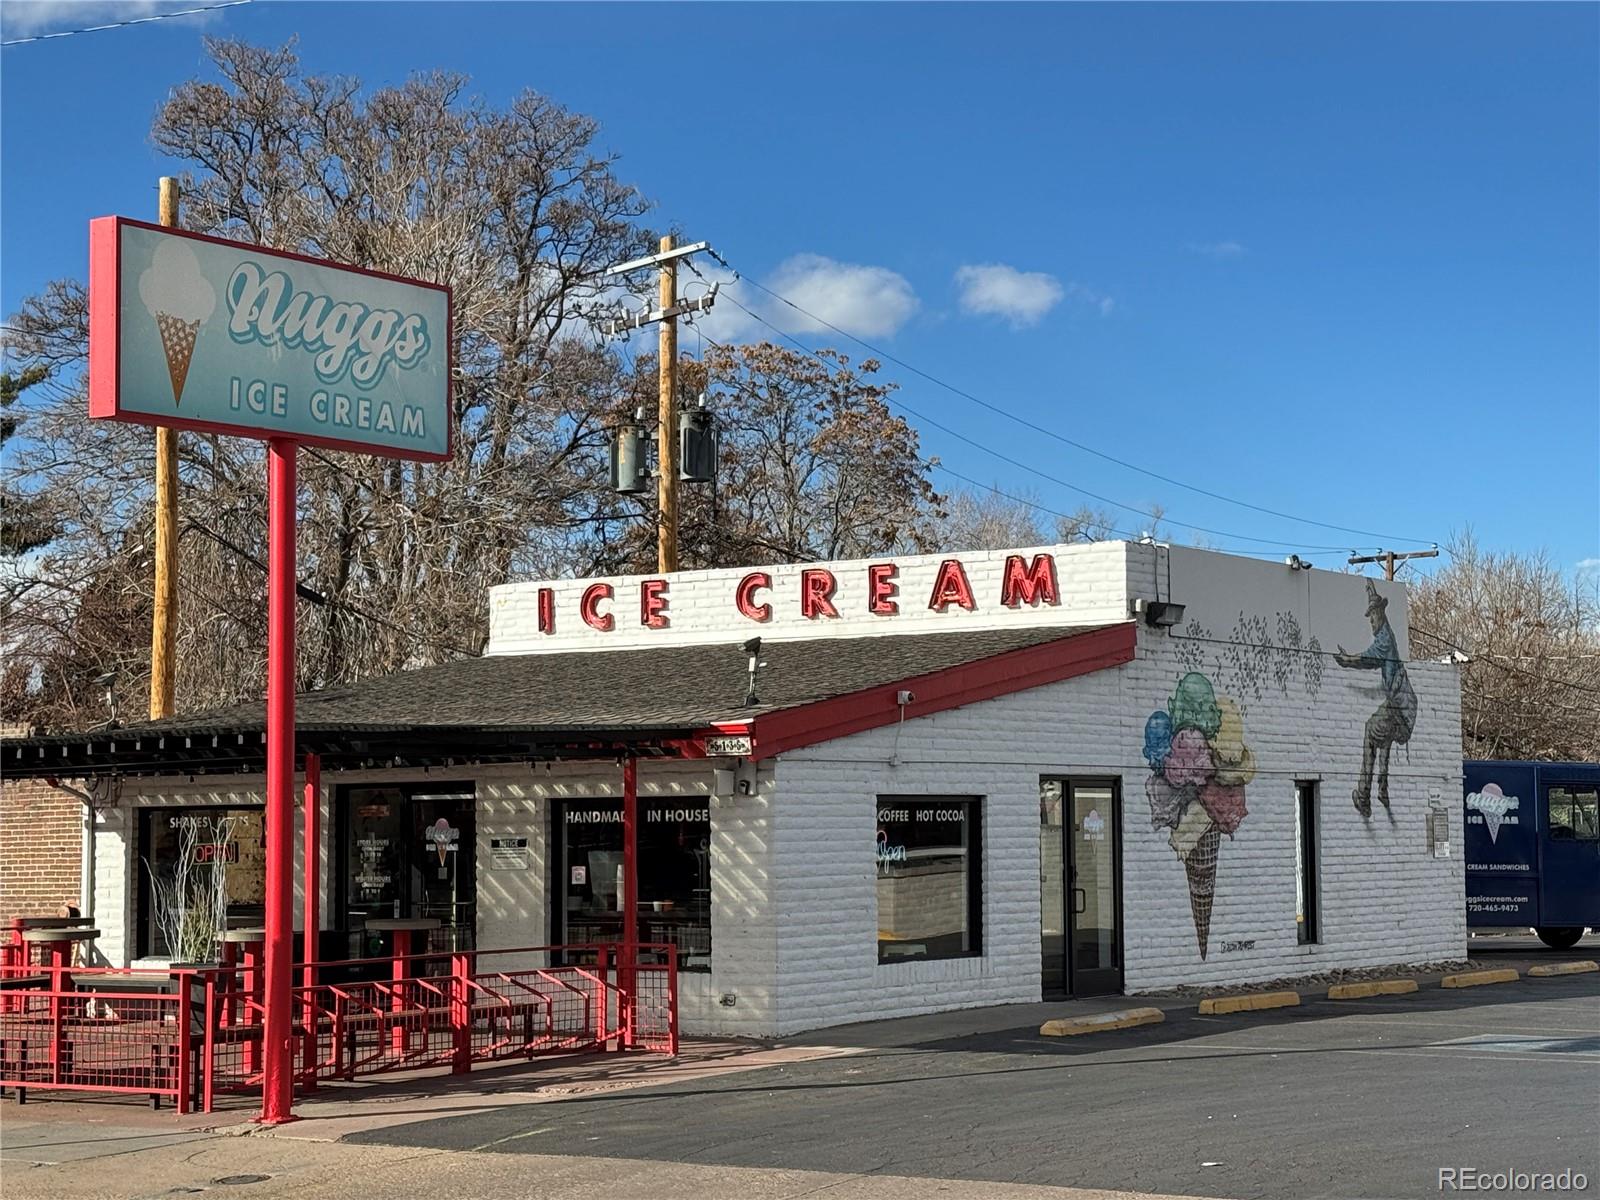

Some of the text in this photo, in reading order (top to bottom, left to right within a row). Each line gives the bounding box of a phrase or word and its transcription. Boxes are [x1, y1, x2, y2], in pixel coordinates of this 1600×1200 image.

[229, 377, 426, 438] ICE CREAM
[537, 553, 1062, 634] ICE CREAM
[565, 809, 709, 824] HANDMAD IN HOUSE
[879, 809, 965, 822] COFFEE HOT COCOA
[1467, 863, 1530, 871] CREAM SANDWICHES
[1468, 904, 1519, 912] 720-465-9473
